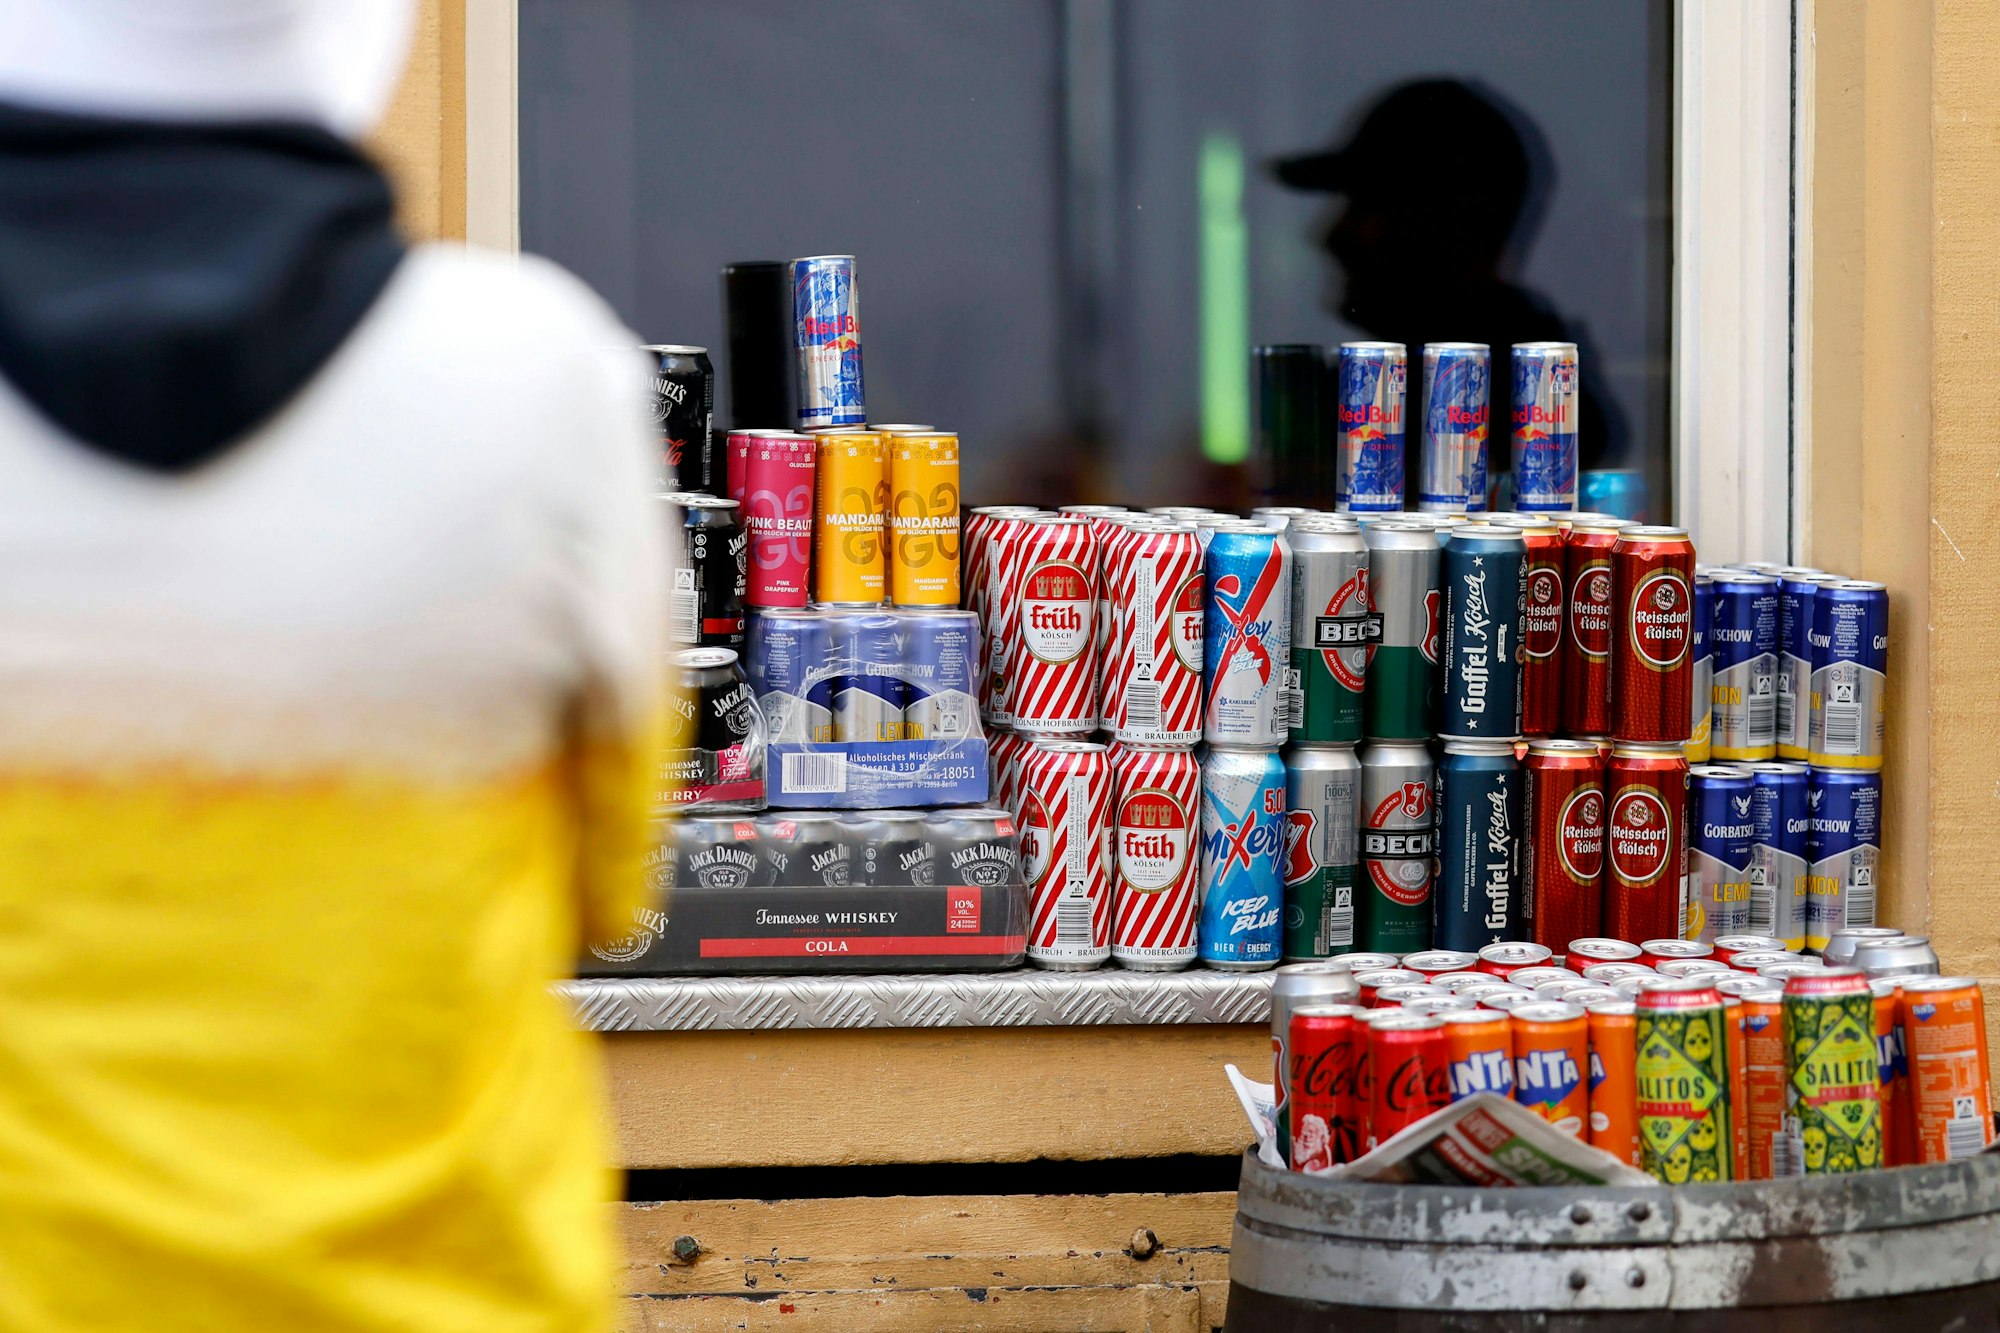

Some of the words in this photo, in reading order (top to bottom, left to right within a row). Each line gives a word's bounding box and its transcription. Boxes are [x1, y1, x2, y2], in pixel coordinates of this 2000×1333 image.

[805, 315, 842, 336] Red
[846, 316, 862, 334] Bu
[1339, 404, 1365, 423] Red
[1369, 405, 1399, 423] Bull
[1448, 404, 1483, 424] Red
[1511, 404, 1528, 423] ed
[1532, 405, 1565, 423] Bull
[747, 516, 773, 529] PINK
[777, 519, 812, 530] BEAUT
[1330, 583, 1354, 613] BRAUEREI
[1463, 570, 1491, 641] Kölsch
[1030, 604, 1081, 633] früh
[1526, 603, 1561, 617] eissdorf
[1636, 611, 1689, 625] Reissdorf
[1041, 631, 1072, 639] KÖLSCH
[1644, 625, 1683, 640] Kölsch
[1229, 651, 1254, 665] ICED
[1233, 658, 1263, 674] BLUE
[1329, 653, 1347, 681] BREMEN
[1460, 645, 1489, 713] Gaffel
[711, 689, 740, 717] JACK
[661, 760, 701, 769] ennessee
[850, 752, 906, 763] Alkoholisches
[909, 751, 965, 763] Mischgetränk
[899, 763, 916, 771] 330
[660, 769, 705, 779] HISKEY
[942, 767, 976, 779] 18051
[1264, 788, 1286, 814] 5,0
[1375, 797, 1399, 825] BRAUEREI
[1487, 787, 1511, 857] Kölsch
[1612, 825, 1667, 840] Reissdorf
[1124, 832, 1175, 862] früh
[1366, 834, 1432, 855] BECK
[1618, 840, 1657, 858] Kölsch
[689, 849, 713, 872] JACK
[716, 845, 758, 874] DANIEL'S
[811, 850, 837, 872] JACK
[899, 849, 925, 871] JACK
[951, 847, 978, 870] JACK
[979, 843, 1017, 869] DANIEL'S
[1134, 860, 1165, 868] KÖLSCH
[1373, 865, 1392, 891] BREMEN
[1484, 860, 1510, 929] Gaffel
[1713, 882, 1751, 902] LEMO
[954, 900, 974, 909] 10%
[1220, 895, 1269, 919] ICED
[756, 909, 819, 925] Tennessee
[825, 912, 898, 923] WHISKEY
[950, 920, 961, 929] 24
[1230, 905, 1280, 935] BLUE
[805, 941, 848, 952] COLA
[1127, 946, 1141, 955] FÜR
[1214, 942, 1234, 953] BIER
[1247, 942, 1272, 953] ENERGY
[1450, 1050, 1513, 1094] NTA
[1514, 1050, 1579, 1090] NTA
[1806, 1059, 1873, 1086] SALITO
